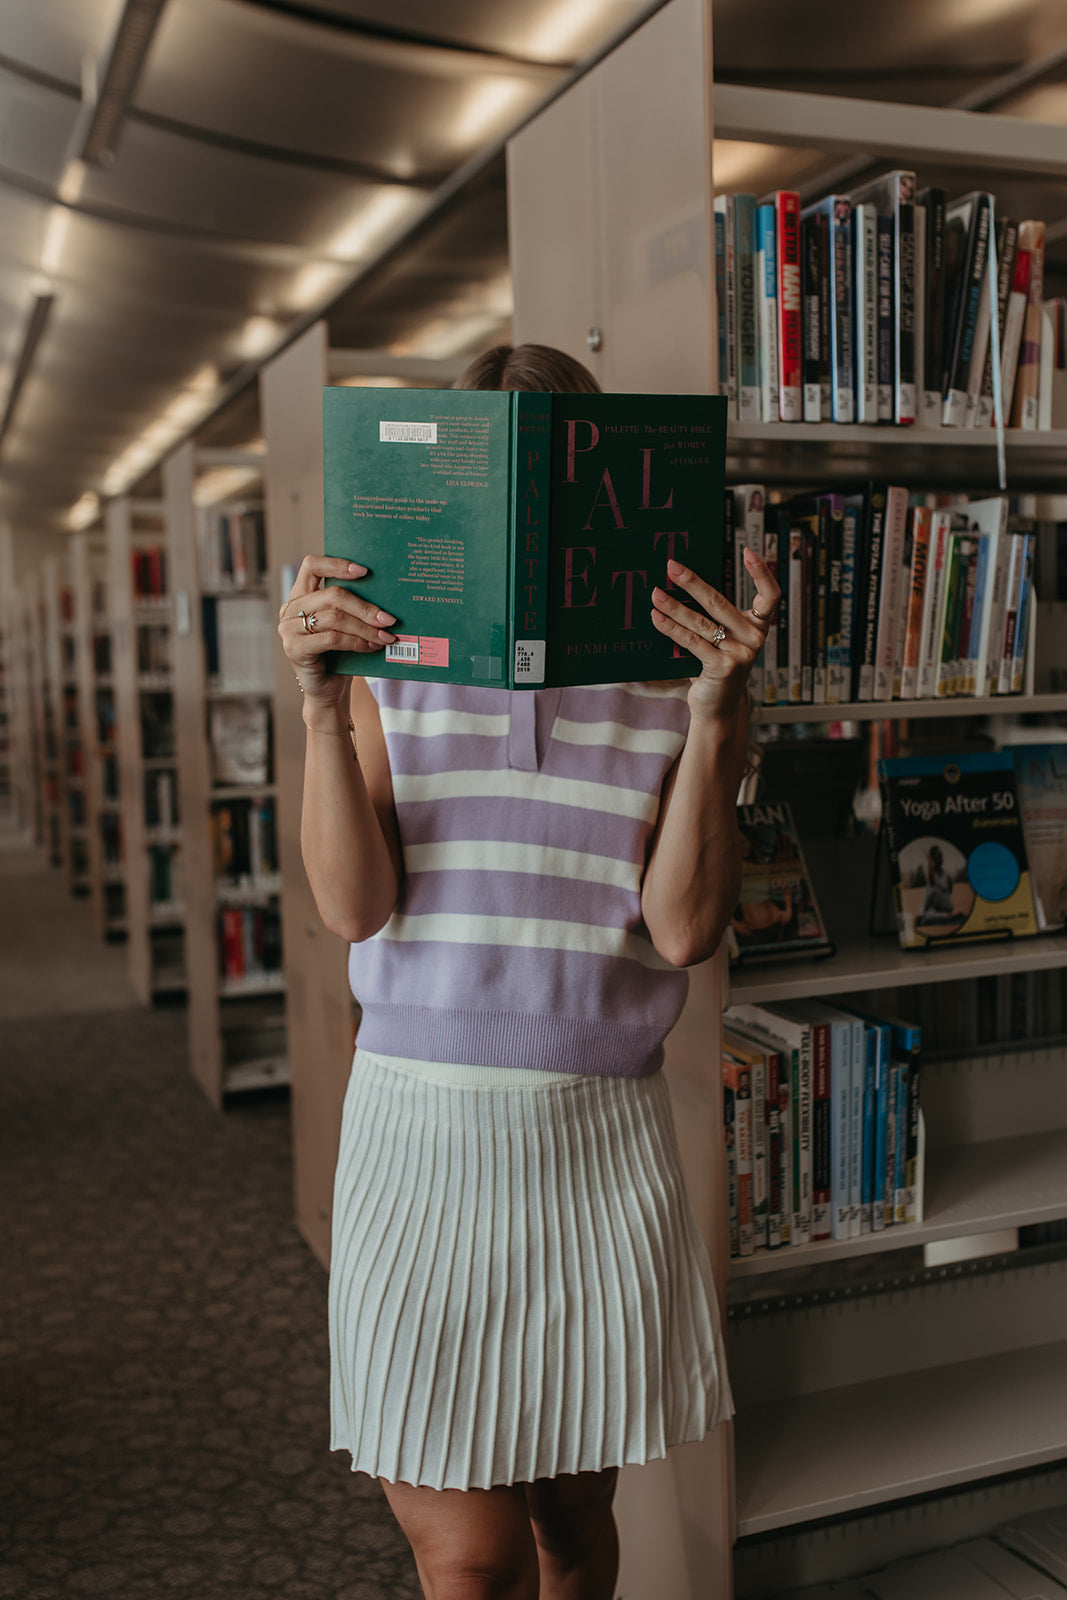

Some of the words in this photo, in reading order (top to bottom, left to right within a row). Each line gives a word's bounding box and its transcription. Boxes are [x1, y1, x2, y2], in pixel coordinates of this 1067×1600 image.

[785, 212, 798, 264] BETTER
[783, 264, 800, 310] MAN
[520, 412, 550, 421] FUNMI
[520, 425, 550, 434] FETTO
[643, 425, 658, 434] The
[658, 424, 690, 434] BEAUTY
[690, 424, 712, 434] BIBLE
[676, 440, 706, 449] WOMEN
[524, 450, 541, 631] PALETTE
[872, 512, 883, 535] THE
[841, 516, 856, 568] BUILT
[869, 537, 881, 571] TOTAL
[830, 560, 842, 593] Fitbit
[841, 570, 854, 595] TO
[913, 543, 928, 597] MOVE
[866, 574, 879, 621] FITNESS
[840, 597, 853, 649] MOVE
[567, 642, 609, 656] FUNMI
[612, 638, 654, 654] FETTO
[864, 623, 875, 665] MANUA
[745, 803, 786, 826] IAN
[899, 797, 940, 822] Yoga
[944, 793, 989, 815] After
[990, 790, 1015, 811] 50
[800, 1031, 810, 1089] FULL-BODY
[800, 1092, 810, 1151] FLEXIBILITY
